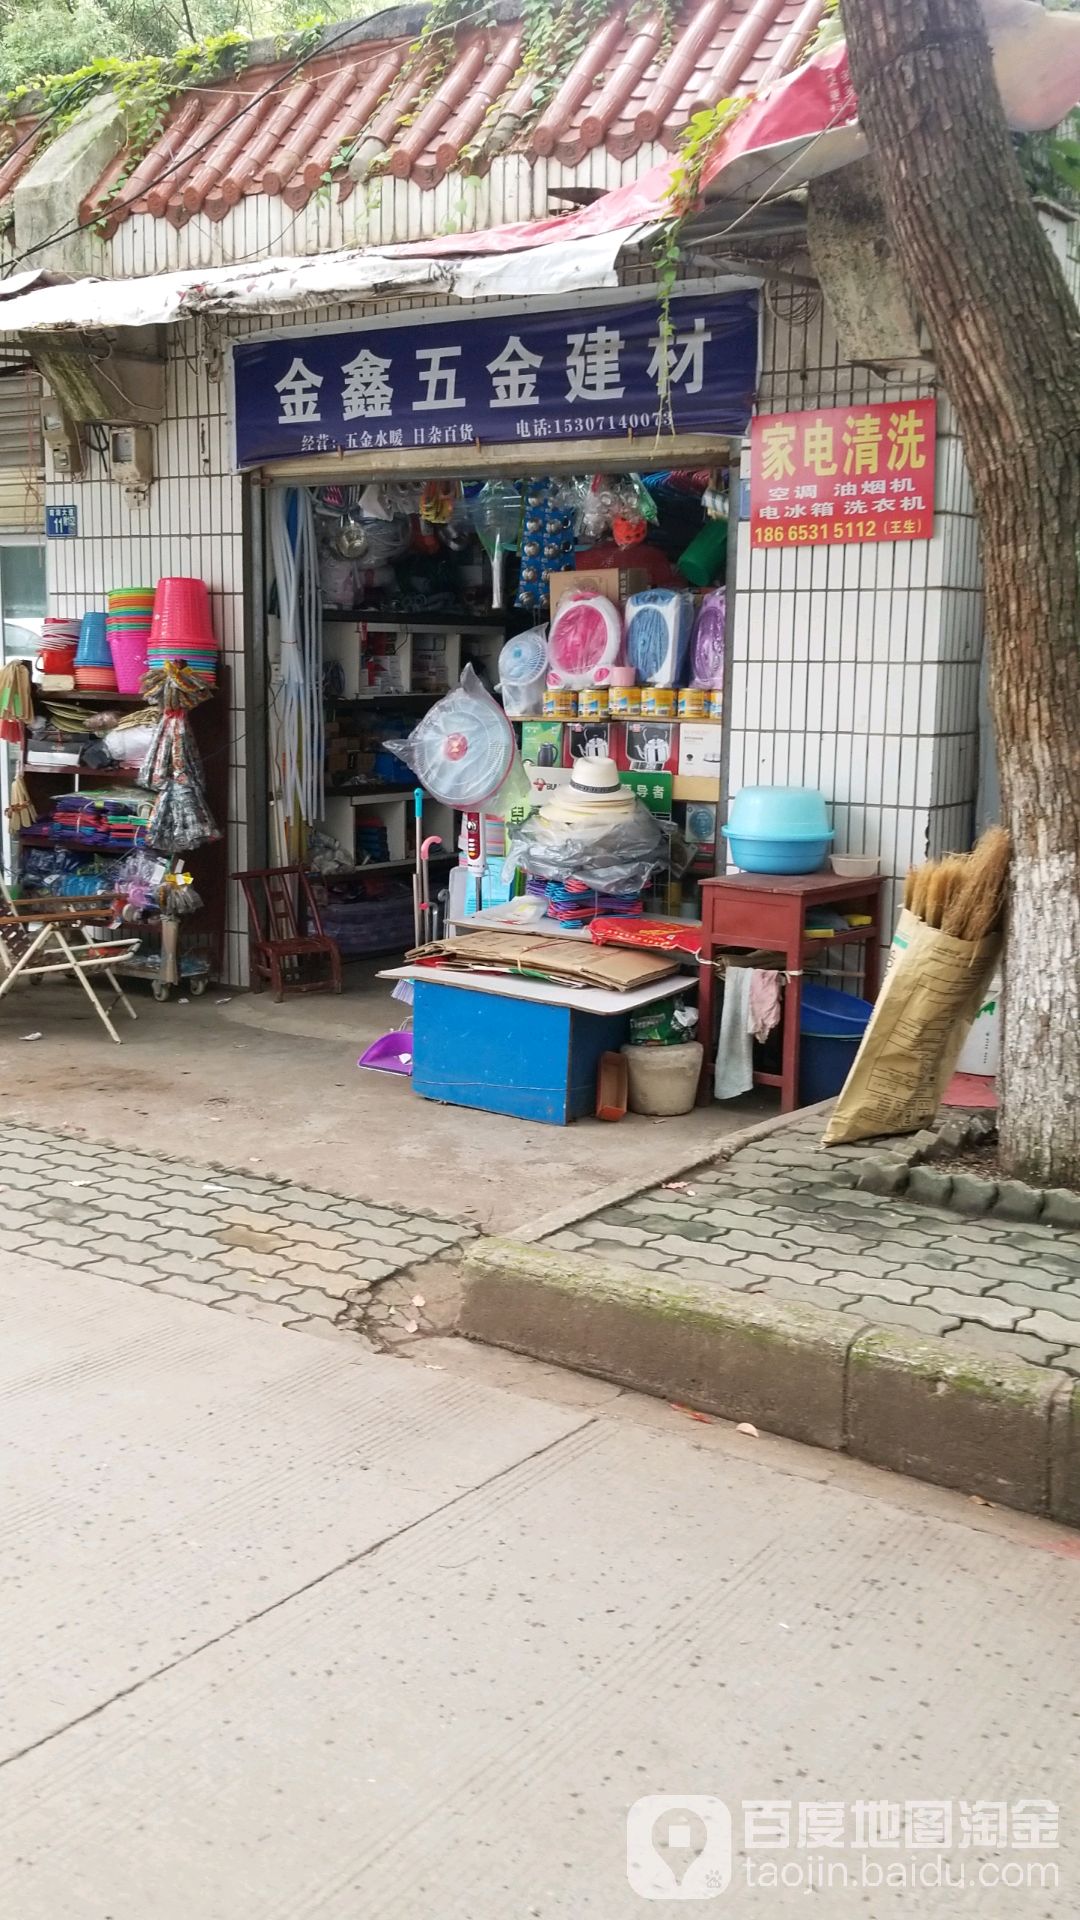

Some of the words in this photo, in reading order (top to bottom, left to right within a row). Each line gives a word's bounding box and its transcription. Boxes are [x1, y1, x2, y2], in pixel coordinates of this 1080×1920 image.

[274, 318, 712, 424] 金鑫五金建材
[345, 428, 404, 449] 五金水暖
[413, 423, 474, 445] 日杂百货
[760, 409, 927, 481] 家电清洗
[768, 484, 818, 501] 空调
[834, 477, 916, 497] 油烟机
[759, 502, 835, 520] 电冰箱
[844, 496, 926, 515] 洗衣机
[755, 526, 784, 543] 186
[788, 522, 829, 541] 6531
[834, 520, 876, 539] 5112
